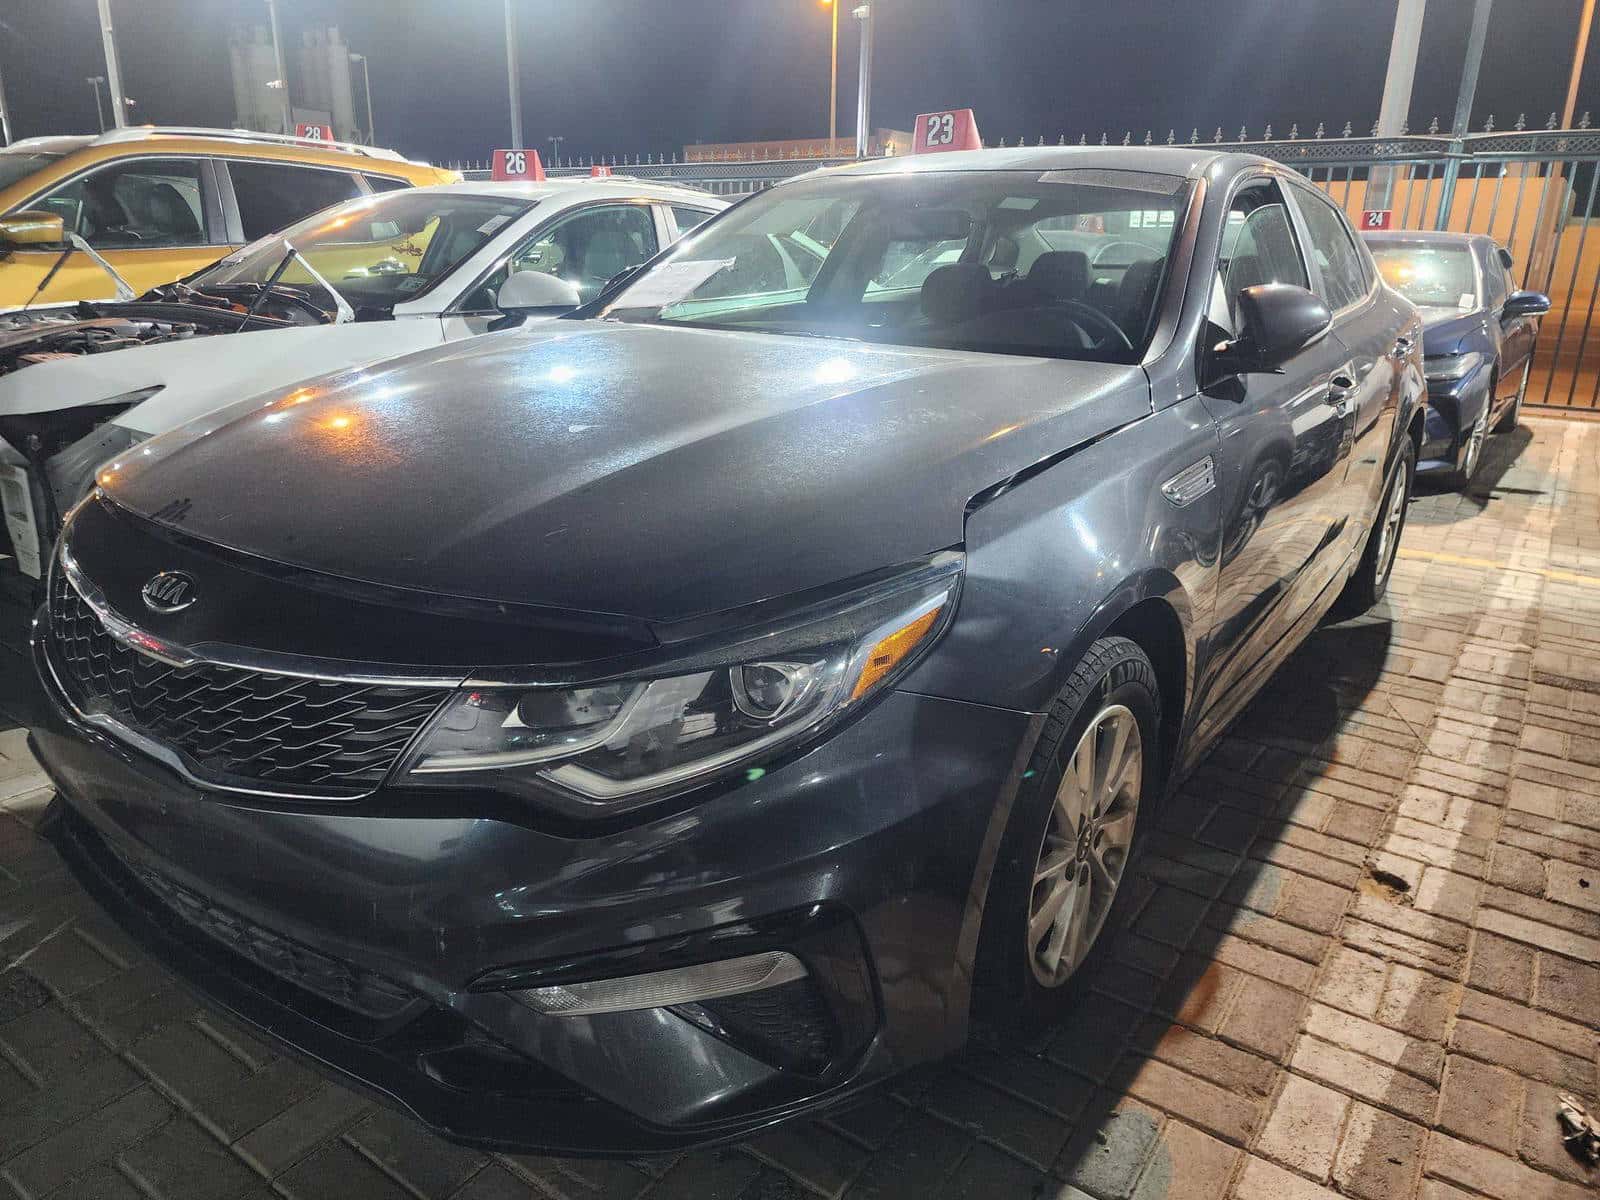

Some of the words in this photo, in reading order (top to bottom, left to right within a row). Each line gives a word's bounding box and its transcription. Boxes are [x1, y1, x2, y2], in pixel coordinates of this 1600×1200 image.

[305, 126, 321, 140] 28
[926, 114, 954, 147] 23
[505, 151, 526, 175] 26
[1368, 212, 1384, 226] 24
[147, 575, 190, 606] KIA
